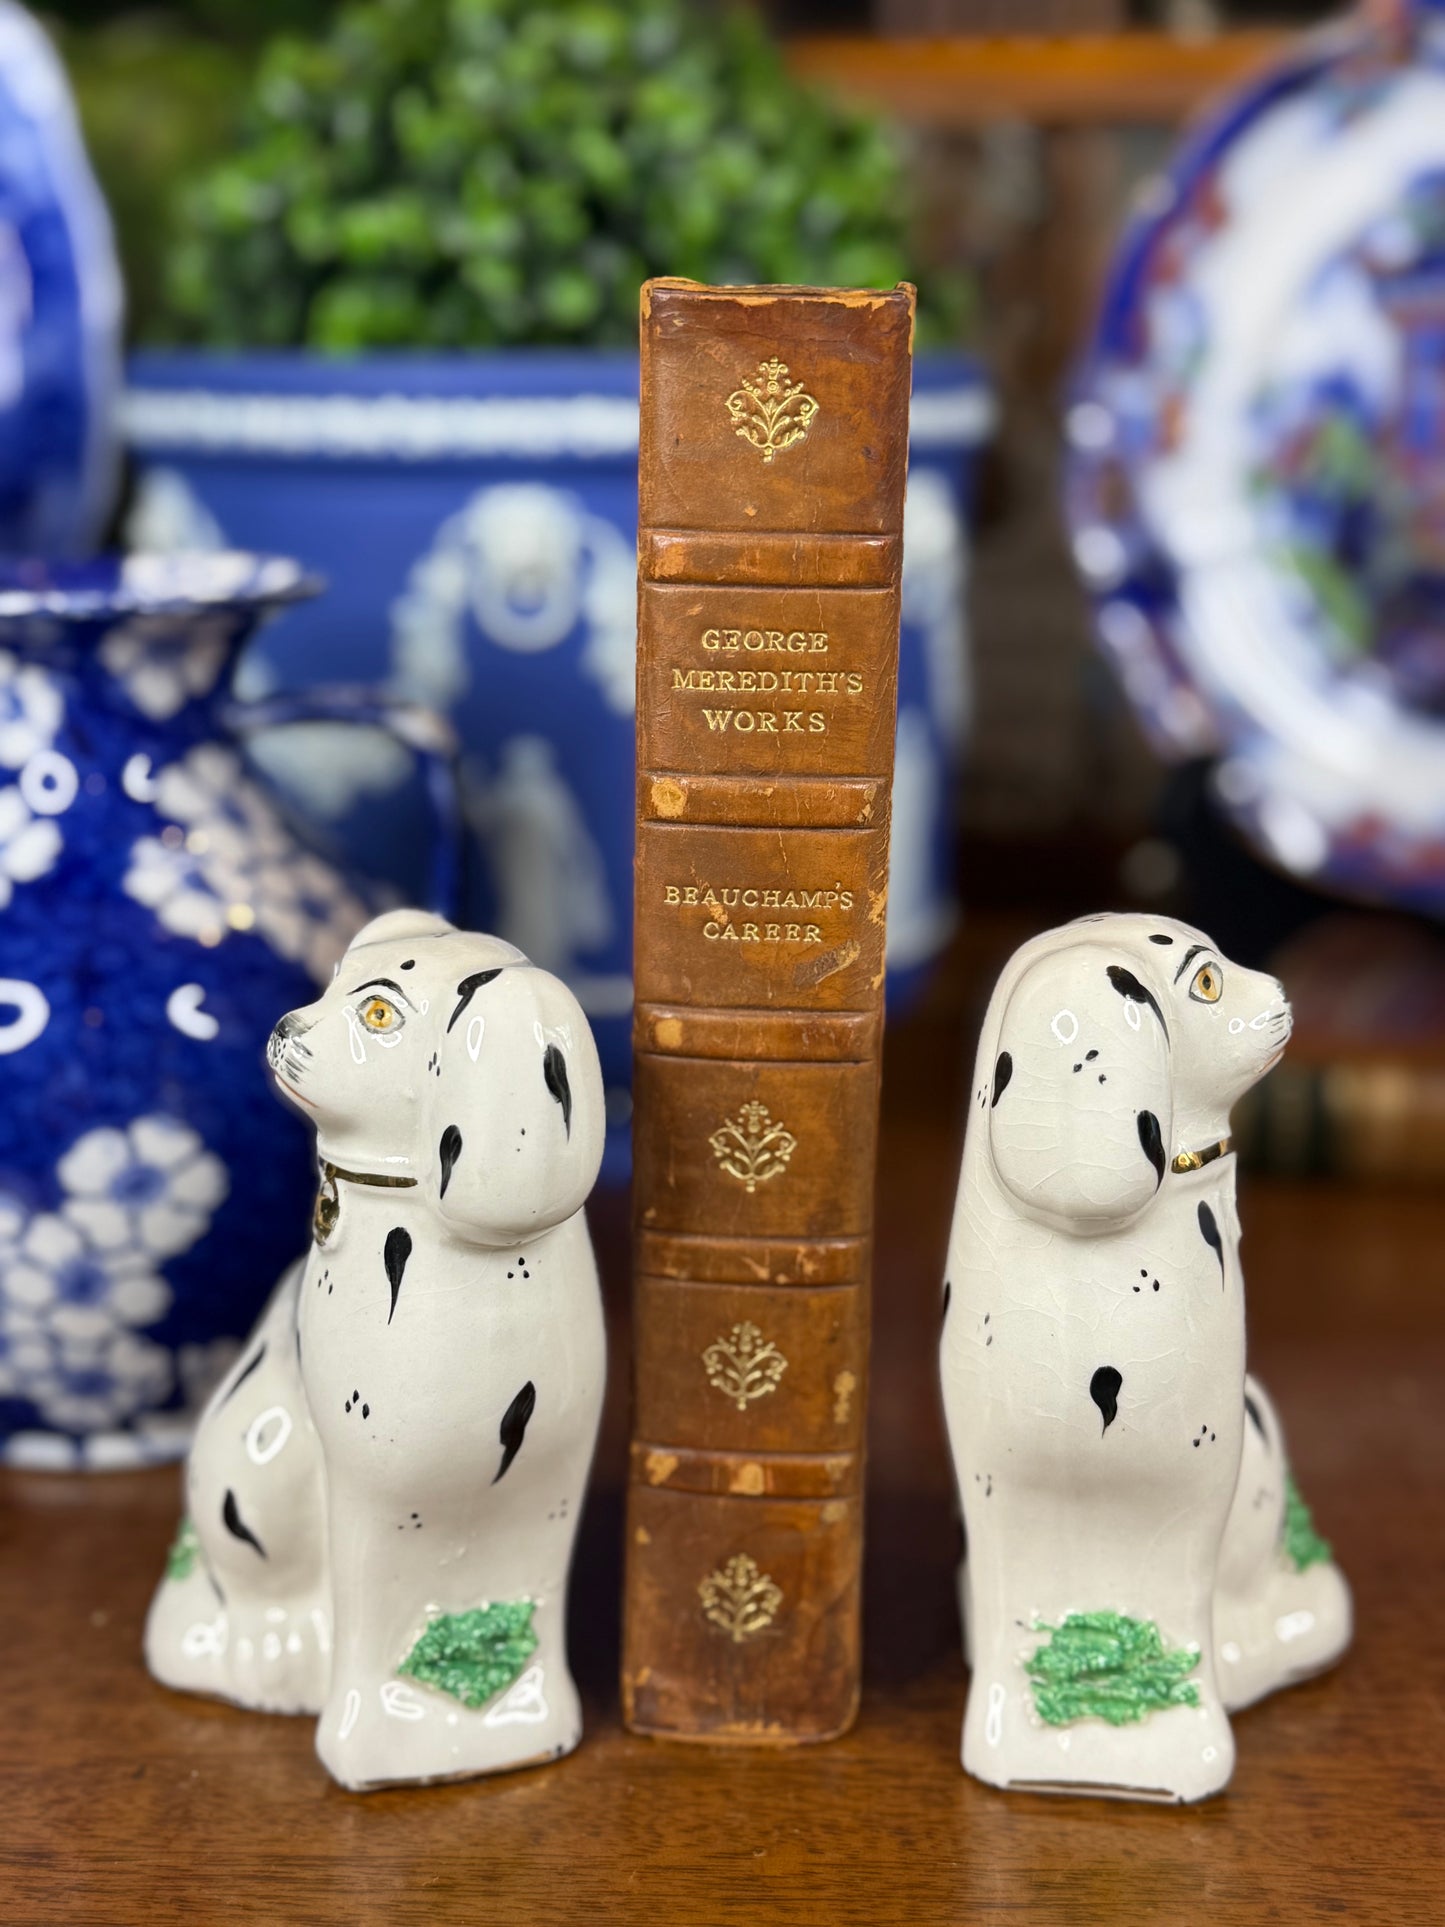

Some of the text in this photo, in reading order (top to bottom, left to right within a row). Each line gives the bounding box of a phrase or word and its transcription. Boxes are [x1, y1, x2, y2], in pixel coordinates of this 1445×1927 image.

[701, 629, 828, 653] GEORGE
[671, 668, 863, 693] MEREDITH'S
[702, 709, 826, 732] WORKS
[664, 882, 853, 909] BEAUCHAMP'S
[703, 922, 822, 942] CAREER
